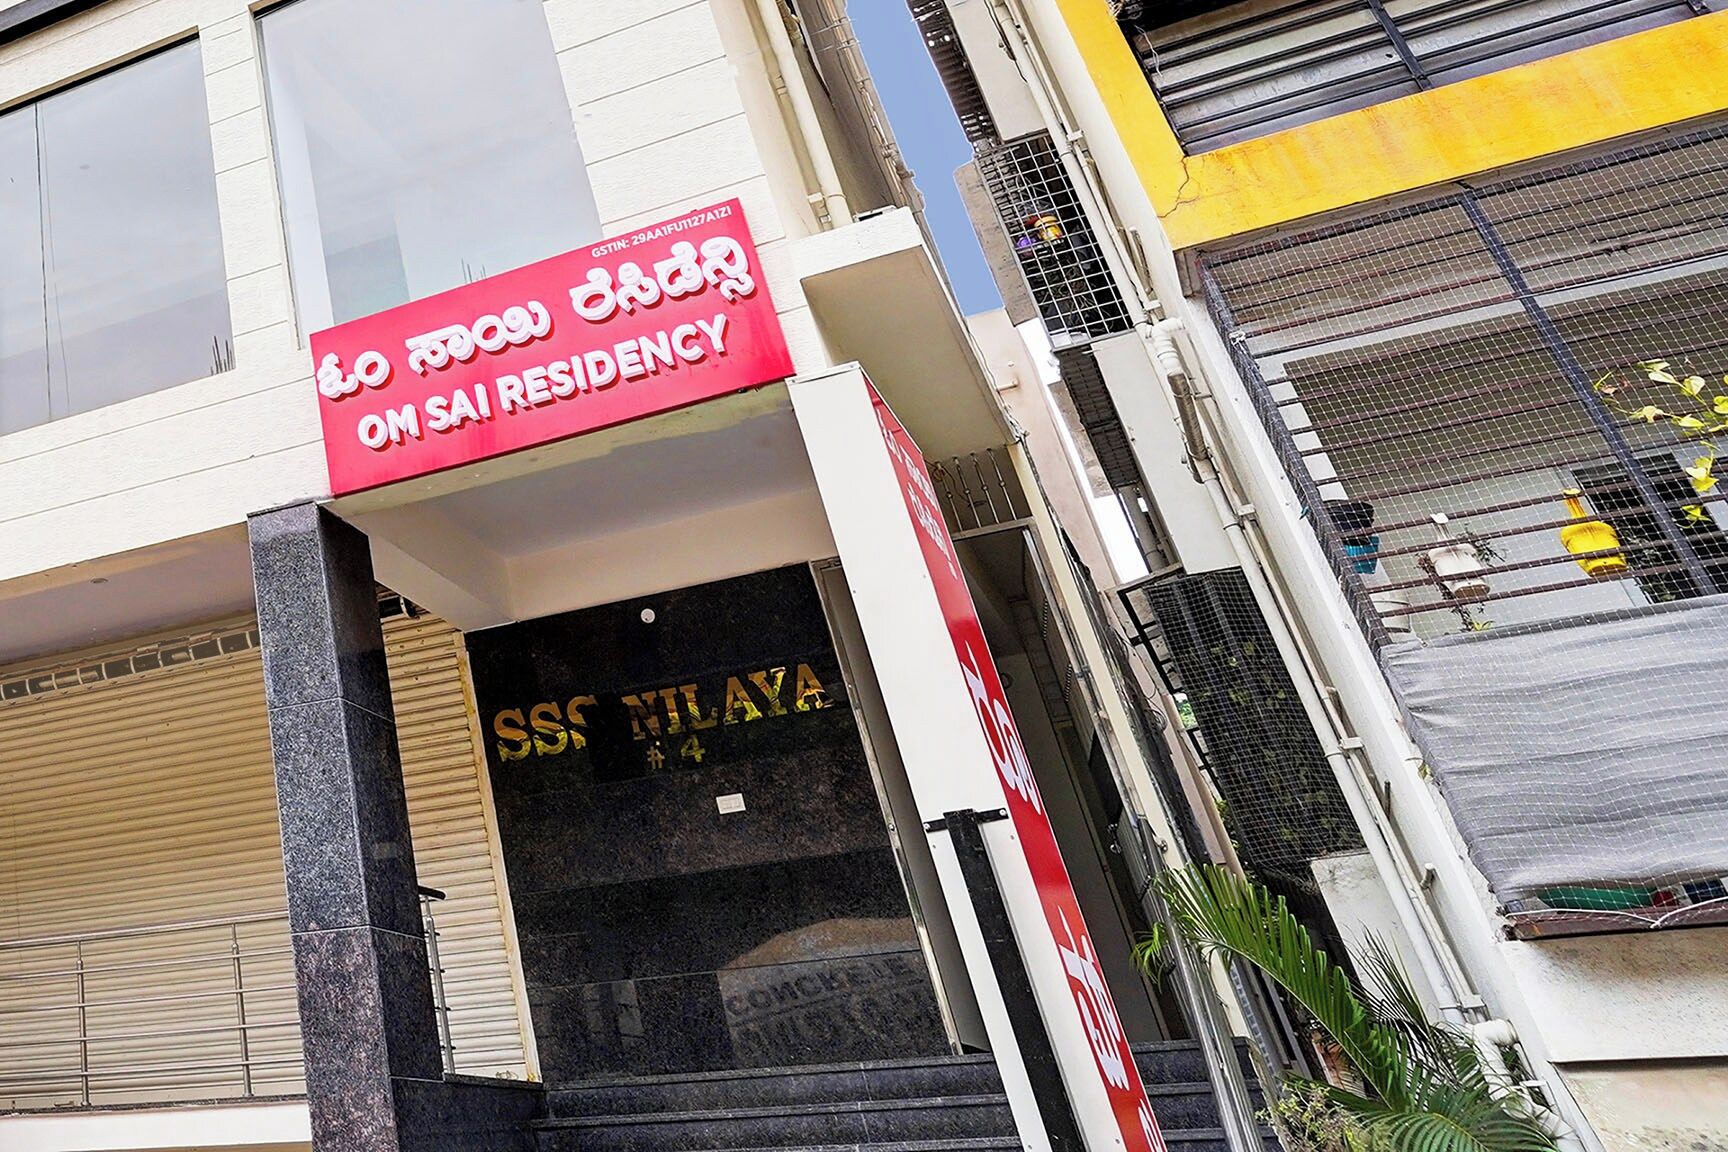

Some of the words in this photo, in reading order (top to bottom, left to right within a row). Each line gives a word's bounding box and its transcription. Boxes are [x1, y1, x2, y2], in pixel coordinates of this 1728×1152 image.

[591, 239, 629, 258] GSTIN:
[404, 300, 552, 375] ಸಾಯಿ
[357, 402, 421, 448] OM
[425, 382, 491, 431] SAI
[495, 312, 728, 413] RESIDENCY
[621, 663, 835, 741] NILAYA
[680, 733, 706, 763] 4
